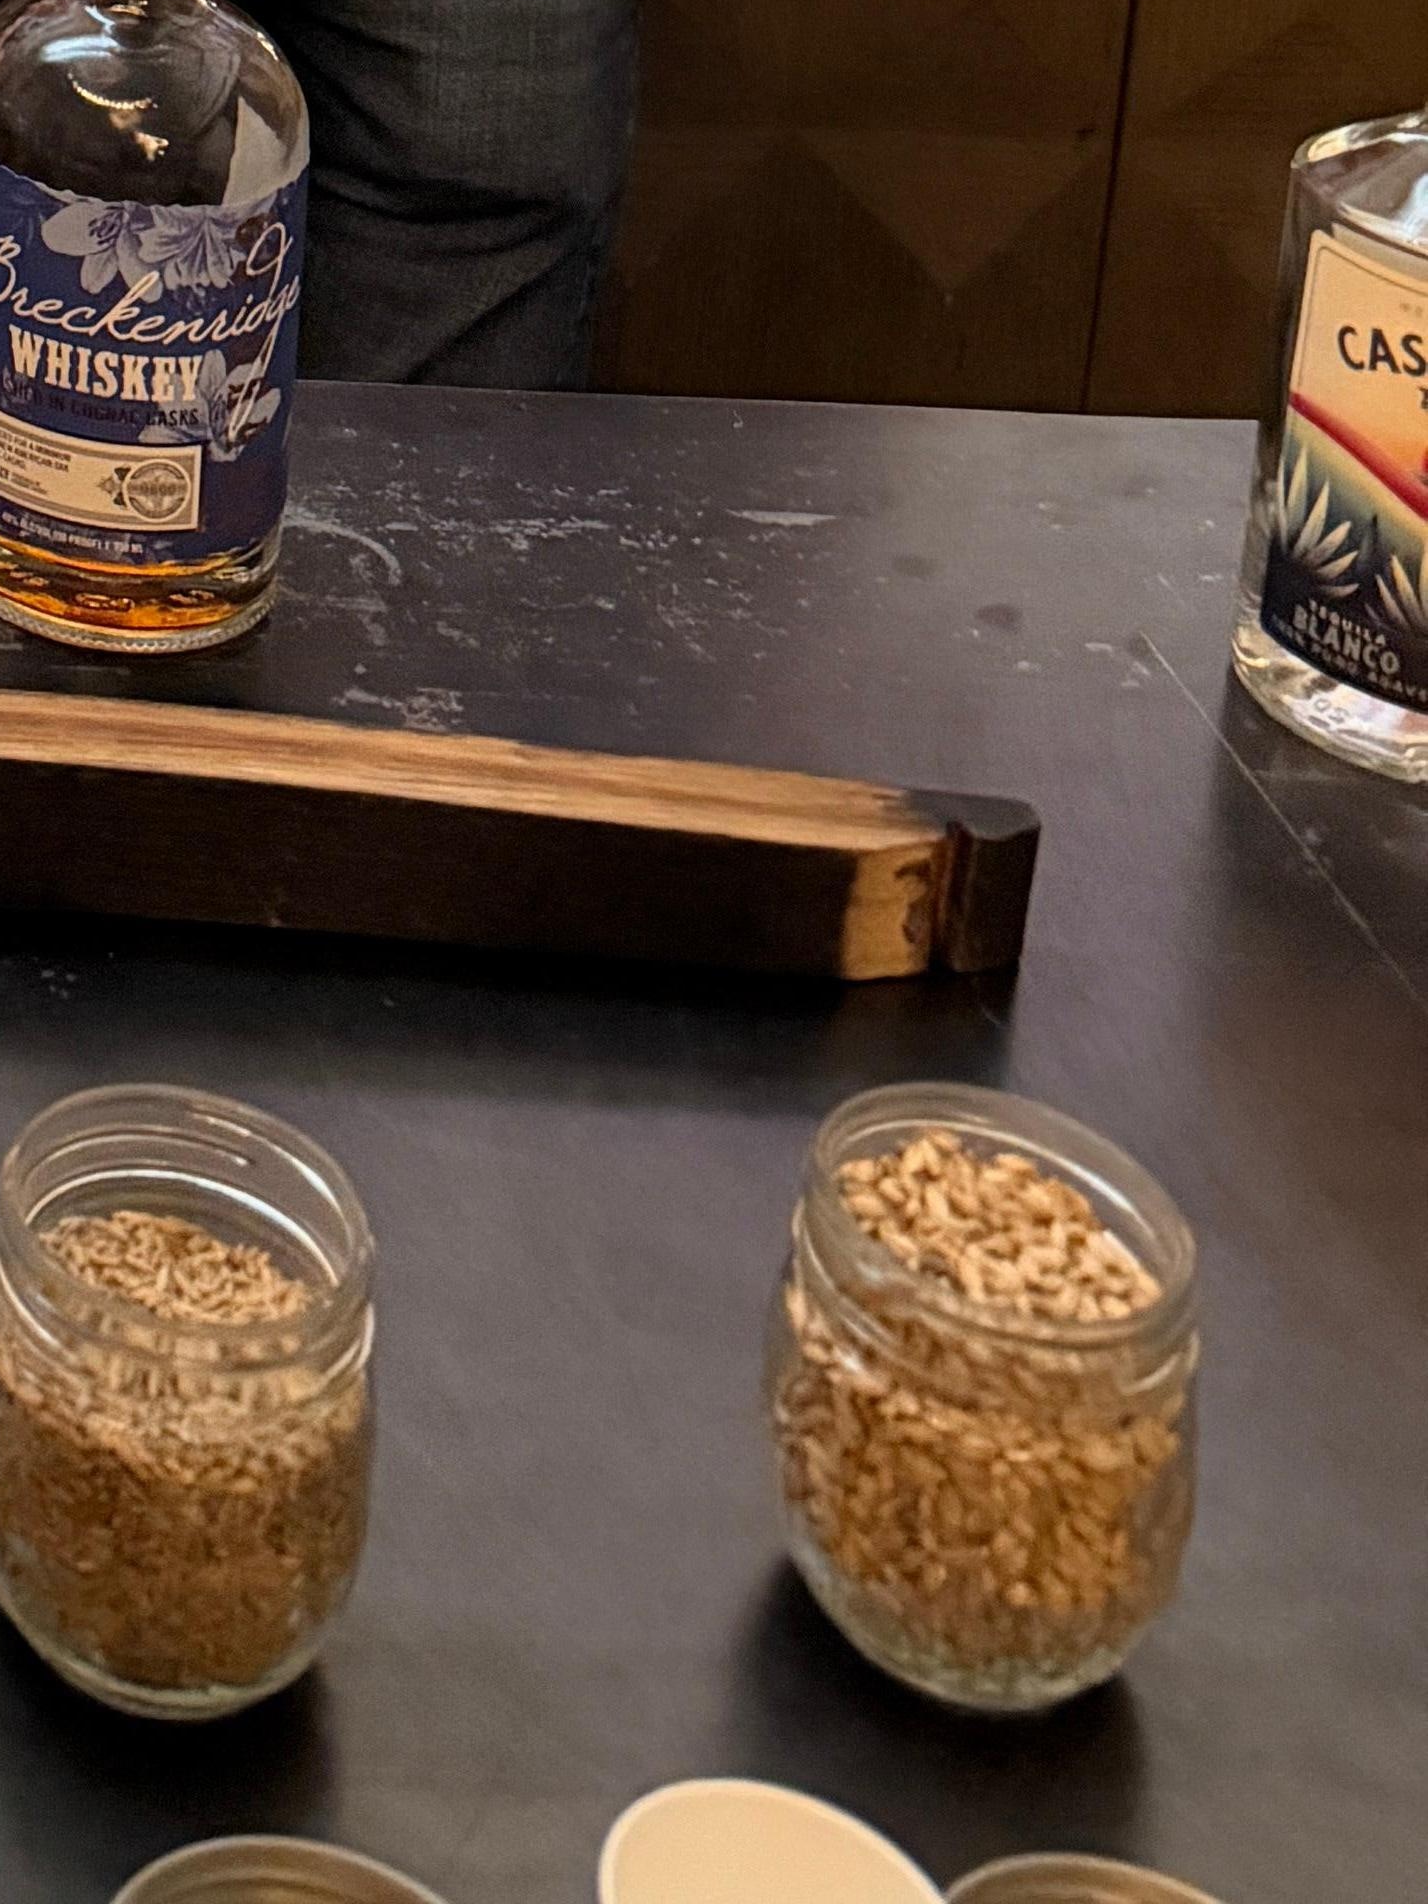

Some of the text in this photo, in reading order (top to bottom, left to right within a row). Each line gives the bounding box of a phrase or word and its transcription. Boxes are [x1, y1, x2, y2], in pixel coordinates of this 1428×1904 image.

[8, 323, 203, 402] WHISKEY
[146, 407, 199, 427] CASKS
[1292, 603, 1400, 676] BLANCO
